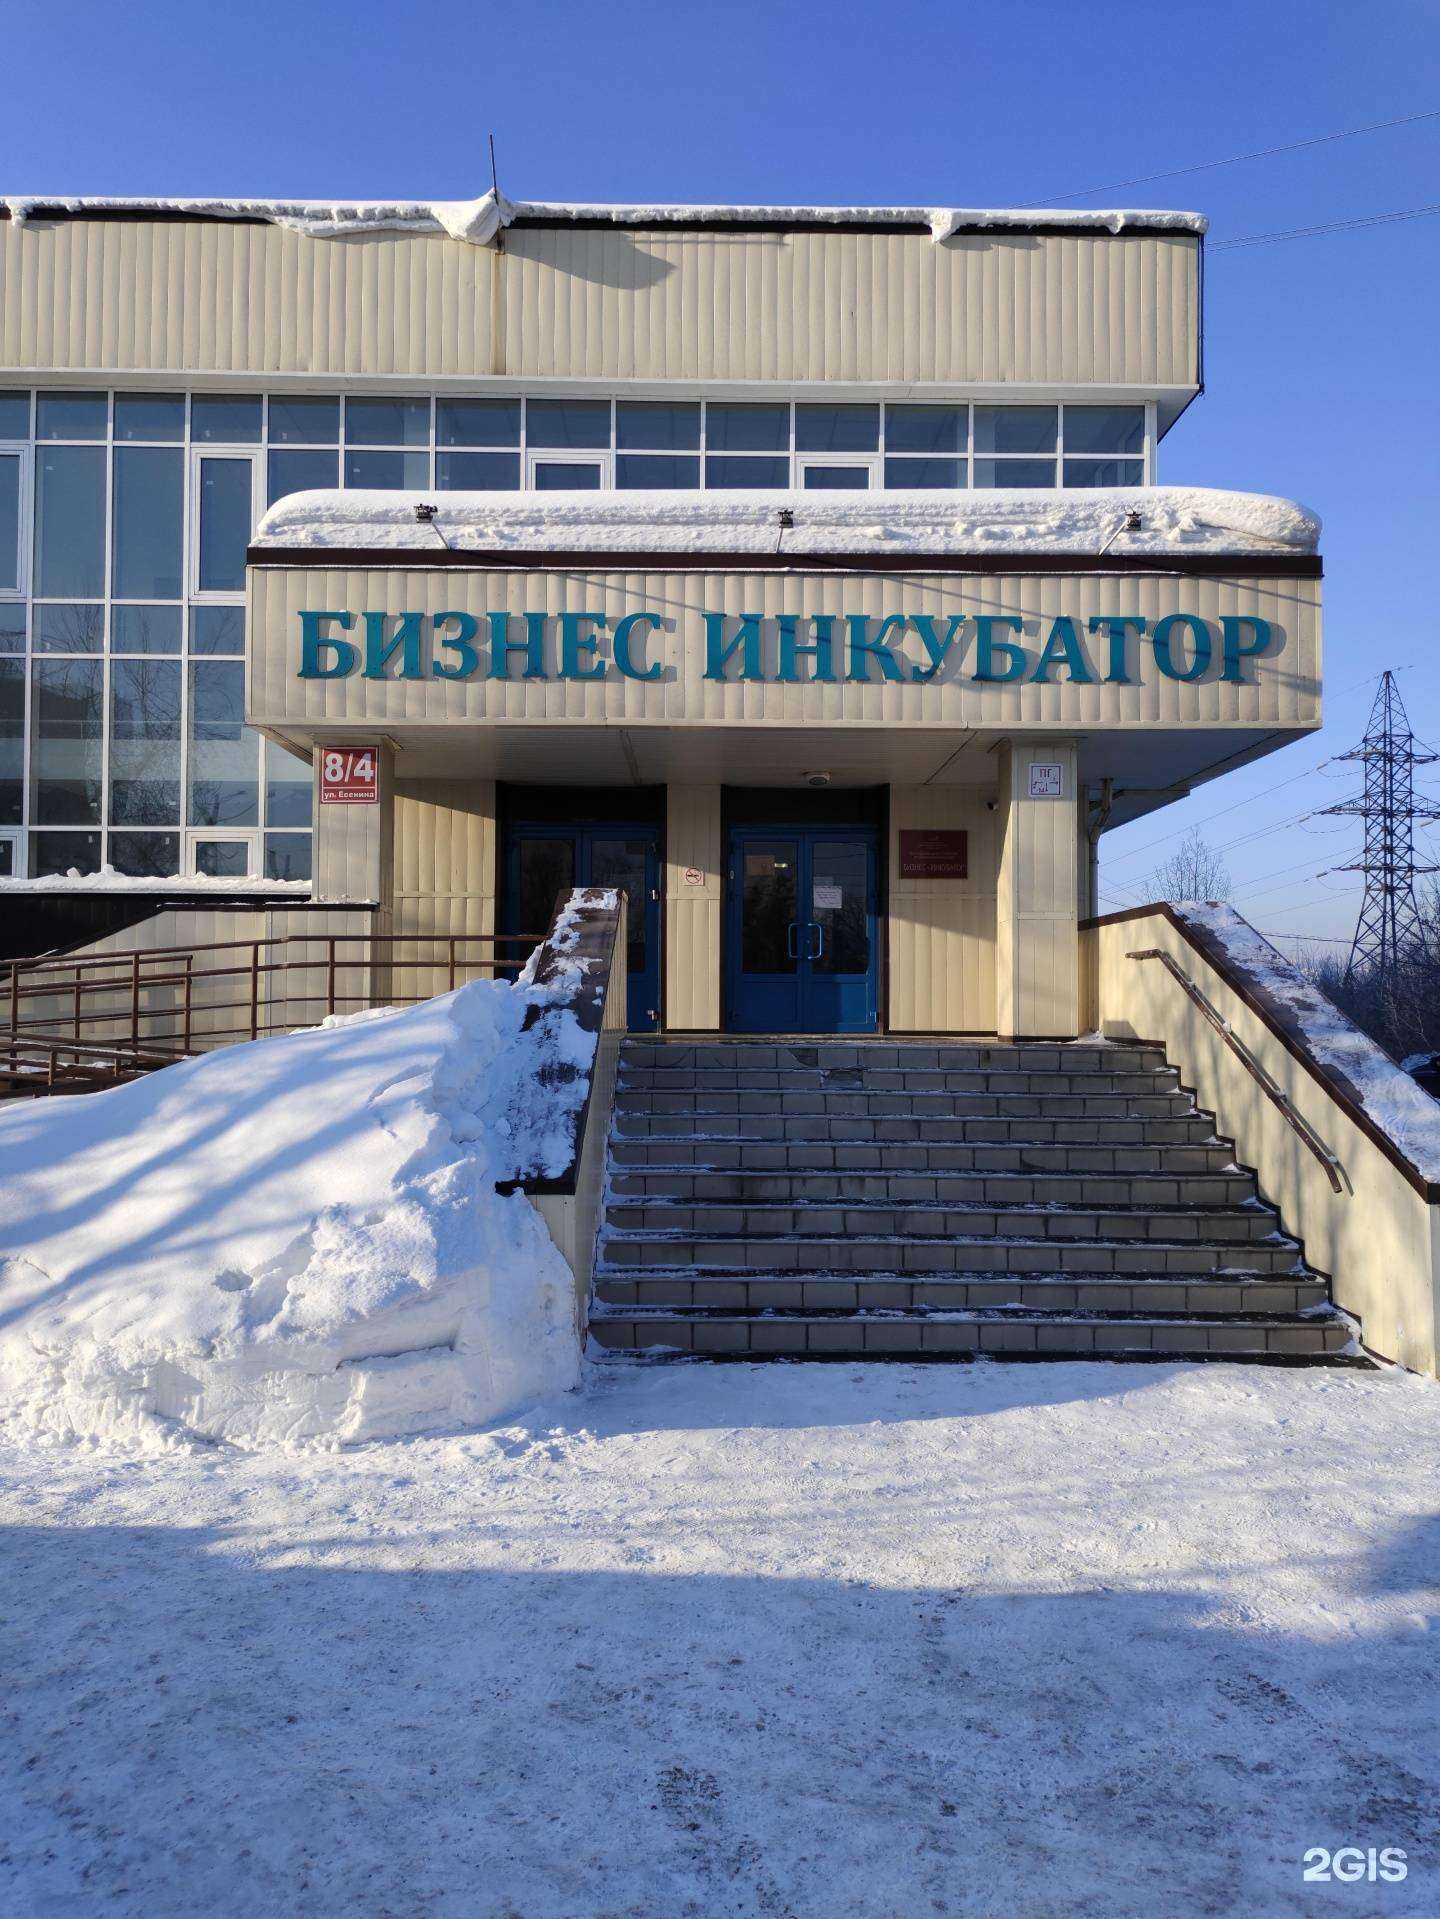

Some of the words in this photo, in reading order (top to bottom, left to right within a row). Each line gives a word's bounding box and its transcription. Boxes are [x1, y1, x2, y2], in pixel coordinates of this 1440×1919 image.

[297, 611, 661, 681] БИЗНЕС
[702, 613, 1271, 682] ИНКУБАТОР
[325, 753, 375, 782] 8/4
